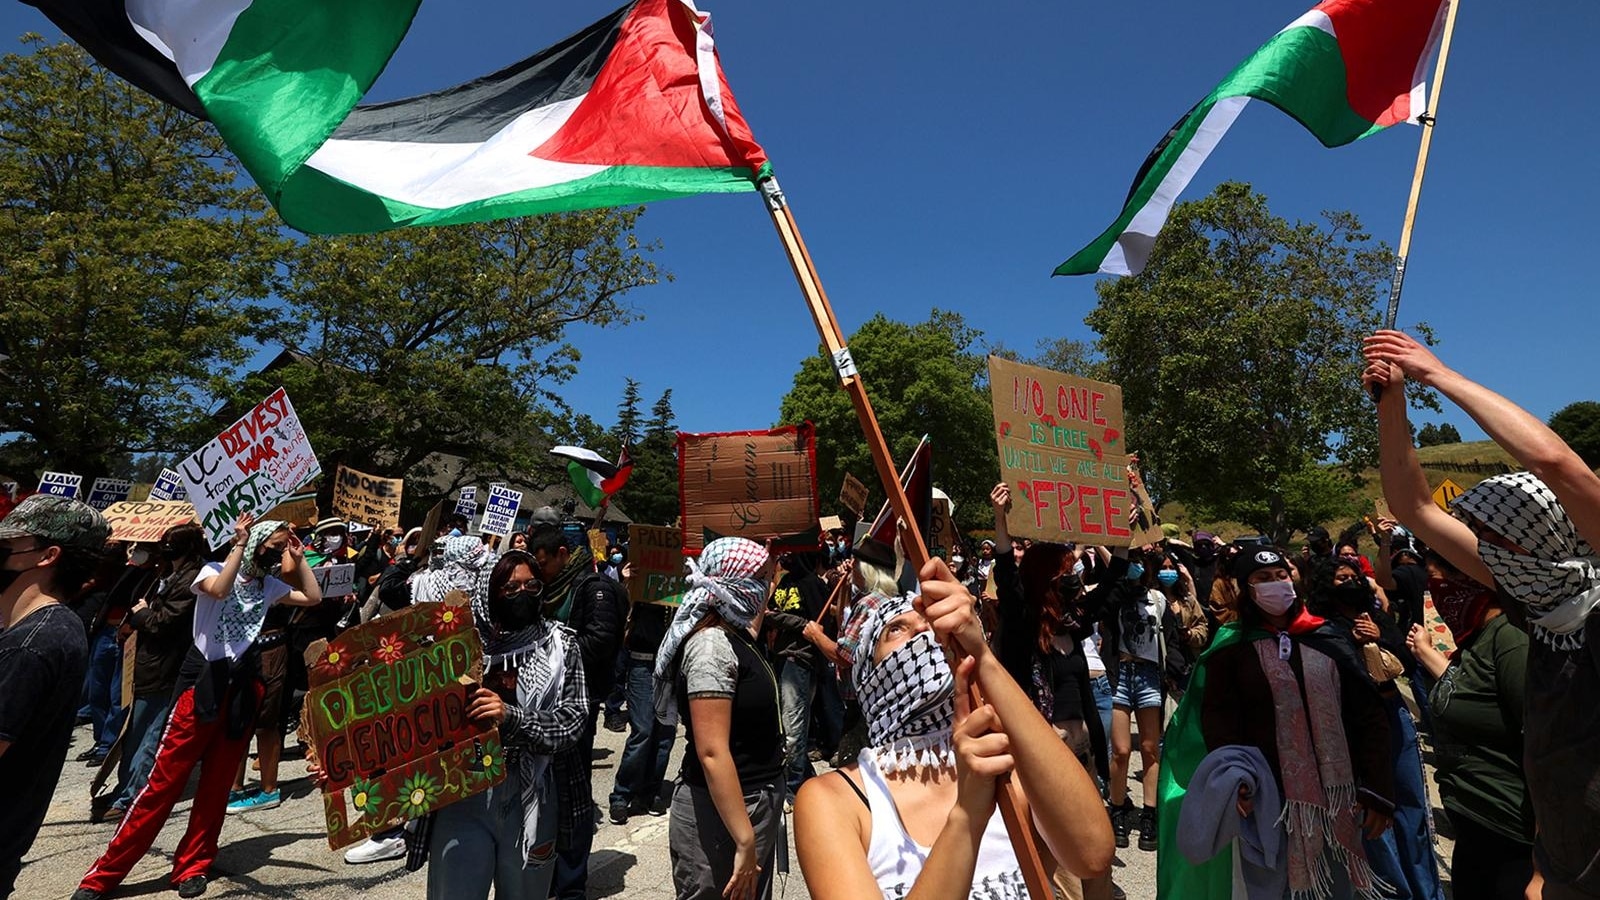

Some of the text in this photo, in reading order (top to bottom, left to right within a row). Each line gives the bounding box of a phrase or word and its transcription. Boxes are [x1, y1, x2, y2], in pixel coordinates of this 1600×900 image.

[1057, 384, 1107, 427] ONE
[182, 388, 289, 485] UC: DIVEST
[1028, 422, 1090, 450] IS FREE
[204, 436, 279, 500] from WAR
[1003, 445, 1124, 482] UNTIL WE ARE ALL
[44, 474, 80, 485] UAW
[161, 470, 180, 483] UAW
[341, 467, 397, 497] NO ONE
[50, 486, 65, 494] ON
[95, 482, 131, 494] UAW
[258, 483, 271, 497] in
[493, 487, 520, 500] UAW
[91, 500, 112, 509] STRI
[112, 502, 165, 515] STOP
[459, 500, 476, 508] UAW
[498, 499, 510, 507] ON
[1032, 480, 1131, 538] FREE
[487, 504, 516, 517] STRIKE
[488, 513, 510, 523] UNFAIR
[488, 519, 507, 528] LABOR
[112, 525, 165, 540] MACHIN
[639, 528, 681, 549] PALES
[320, 639, 471, 730] DEFUND
[325, 692, 463, 783] GENOCID
